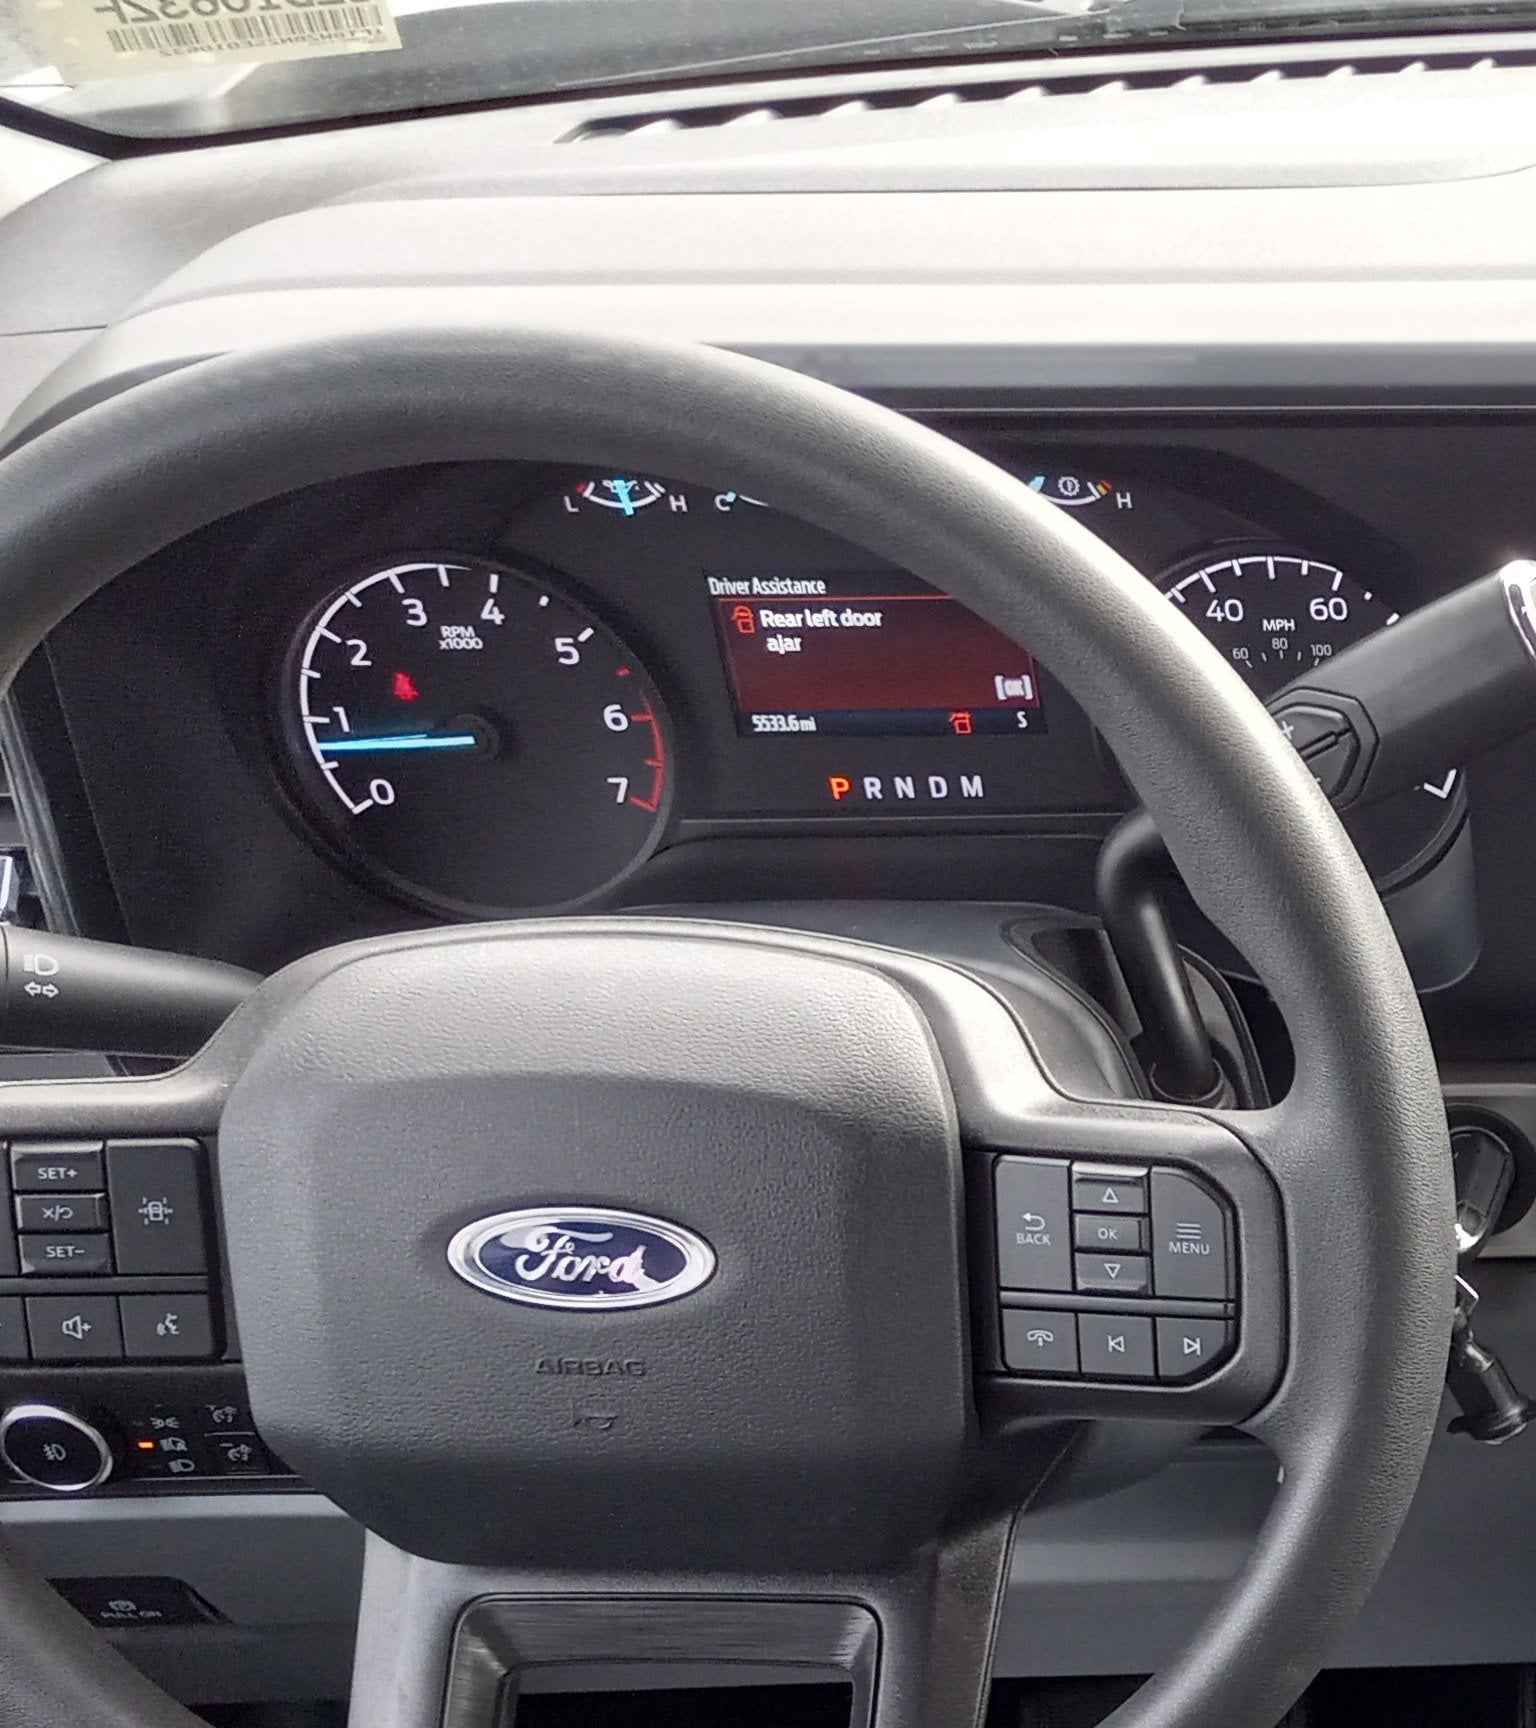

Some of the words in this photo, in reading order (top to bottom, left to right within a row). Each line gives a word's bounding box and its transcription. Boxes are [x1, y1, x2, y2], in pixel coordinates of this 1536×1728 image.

[564, 496, 579, 513] L
[670, 495, 688, 513] H
[715, 494, 732, 512] C
[1116, 492, 1134, 510] H
[708, 577, 750, 595] Driver
[752, 577, 827, 595] Assistance
[402, 598, 428, 626] 3
[480, 598, 505, 625] 4
[1206, 599, 1244, 622] 40
[1310, 597, 1348, 621] 60
[760, 609, 803, 628] Rear
[805, 609, 839, 628] left
[840, 609, 883, 627] door
[1262, 618, 1295, 632] MPH
[440, 625, 475, 638] RPM
[345, 639, 372, 666] 2
[438, 637, 483, 650] x1000
[554, 638, 580, 665] 5
[766, 635, 802, 654] ajar
[1272, 637, 1288, 651] 80
[1310, 643, 1332, 657] 100
[1232, 647, 1249, 660] 60
[333, 706, 351, 733] 1
[603, 704, 629, 731] 6
[1017, 710, 1028, 728] S
[369, 779, 395, 805] 0
[606, 777, 628, 803] 7
[829, 776, 850, 800] P
[863, 776, 882, 800] R
[894, 776, 915, 799] N
[928, 776, 947, 798] D
[961, 775, 984, 798] M
[1016, 1232, 1051, 1246] BACK
[1098, 1228, 1118, 1240] OK
[512, 1225, 652, 1285] Ford
[1169, 1241, 1210, 1255] MENU
[534, 1358, 648, 1377] AIRBAG
